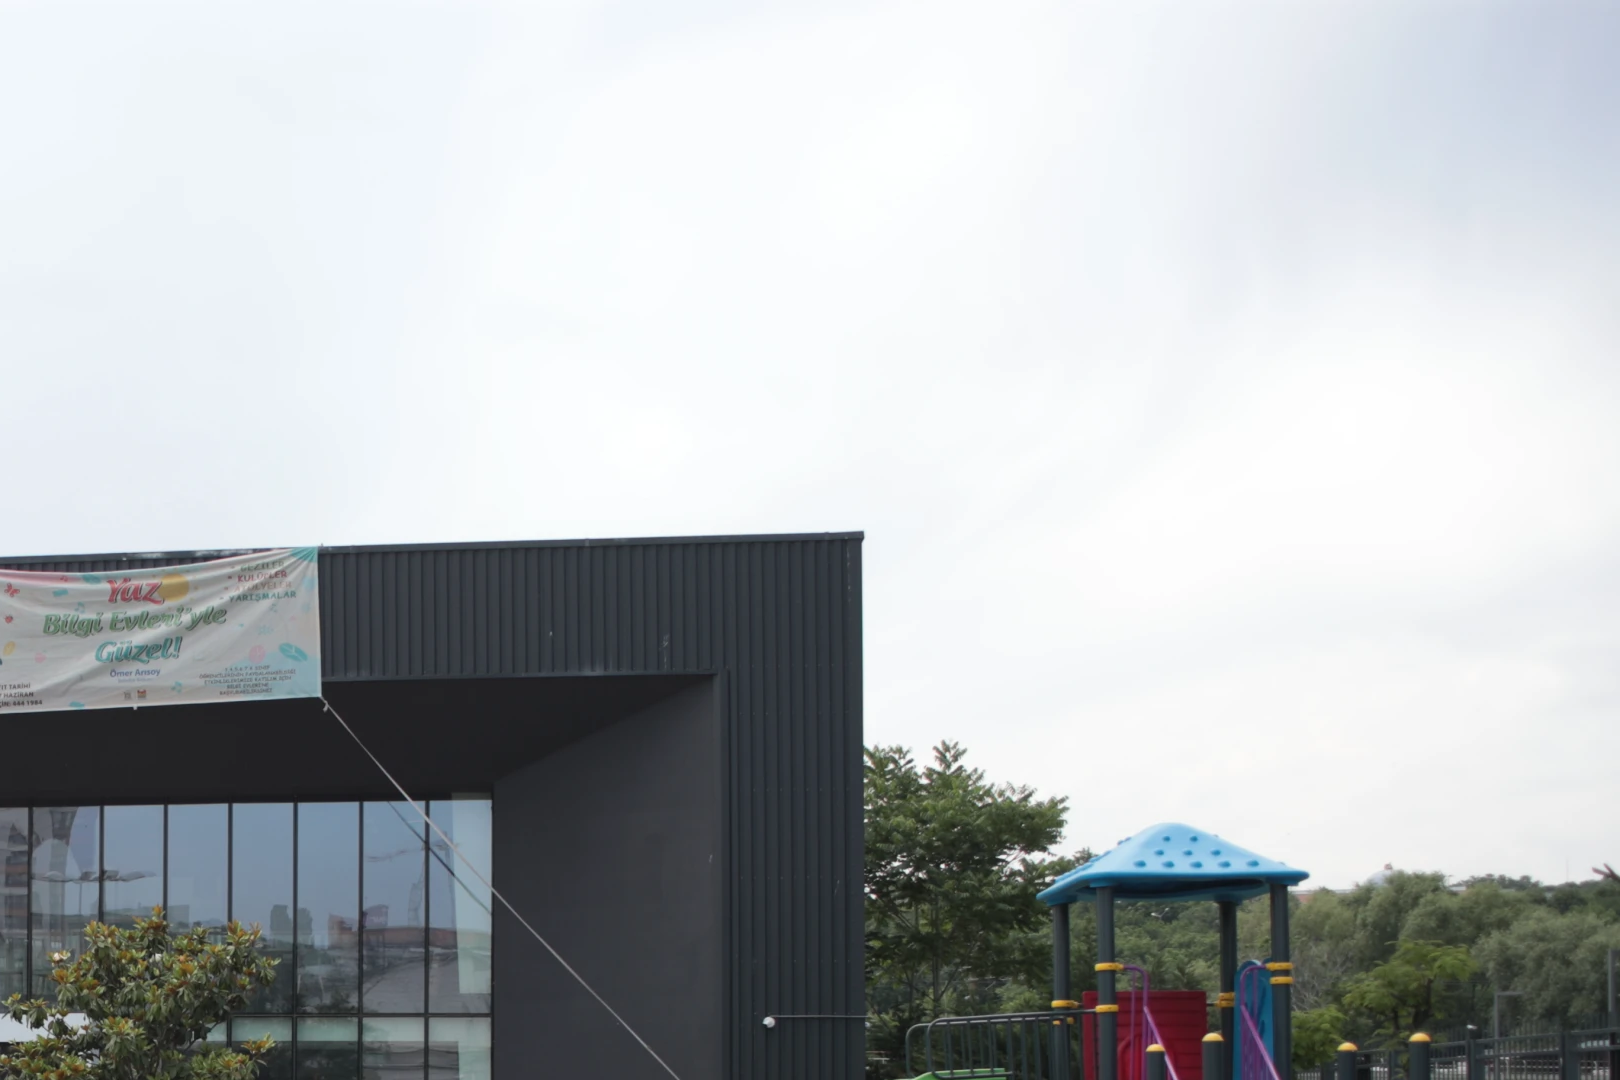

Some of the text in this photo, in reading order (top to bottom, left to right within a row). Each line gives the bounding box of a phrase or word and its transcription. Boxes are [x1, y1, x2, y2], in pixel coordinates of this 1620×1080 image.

[106, 578, 165, 605] Yaz
[43, 611, 103, 638] Bilgi
[95, 636, 183, 664] Güzel!
[110, 669, 133, 677] Ömer
